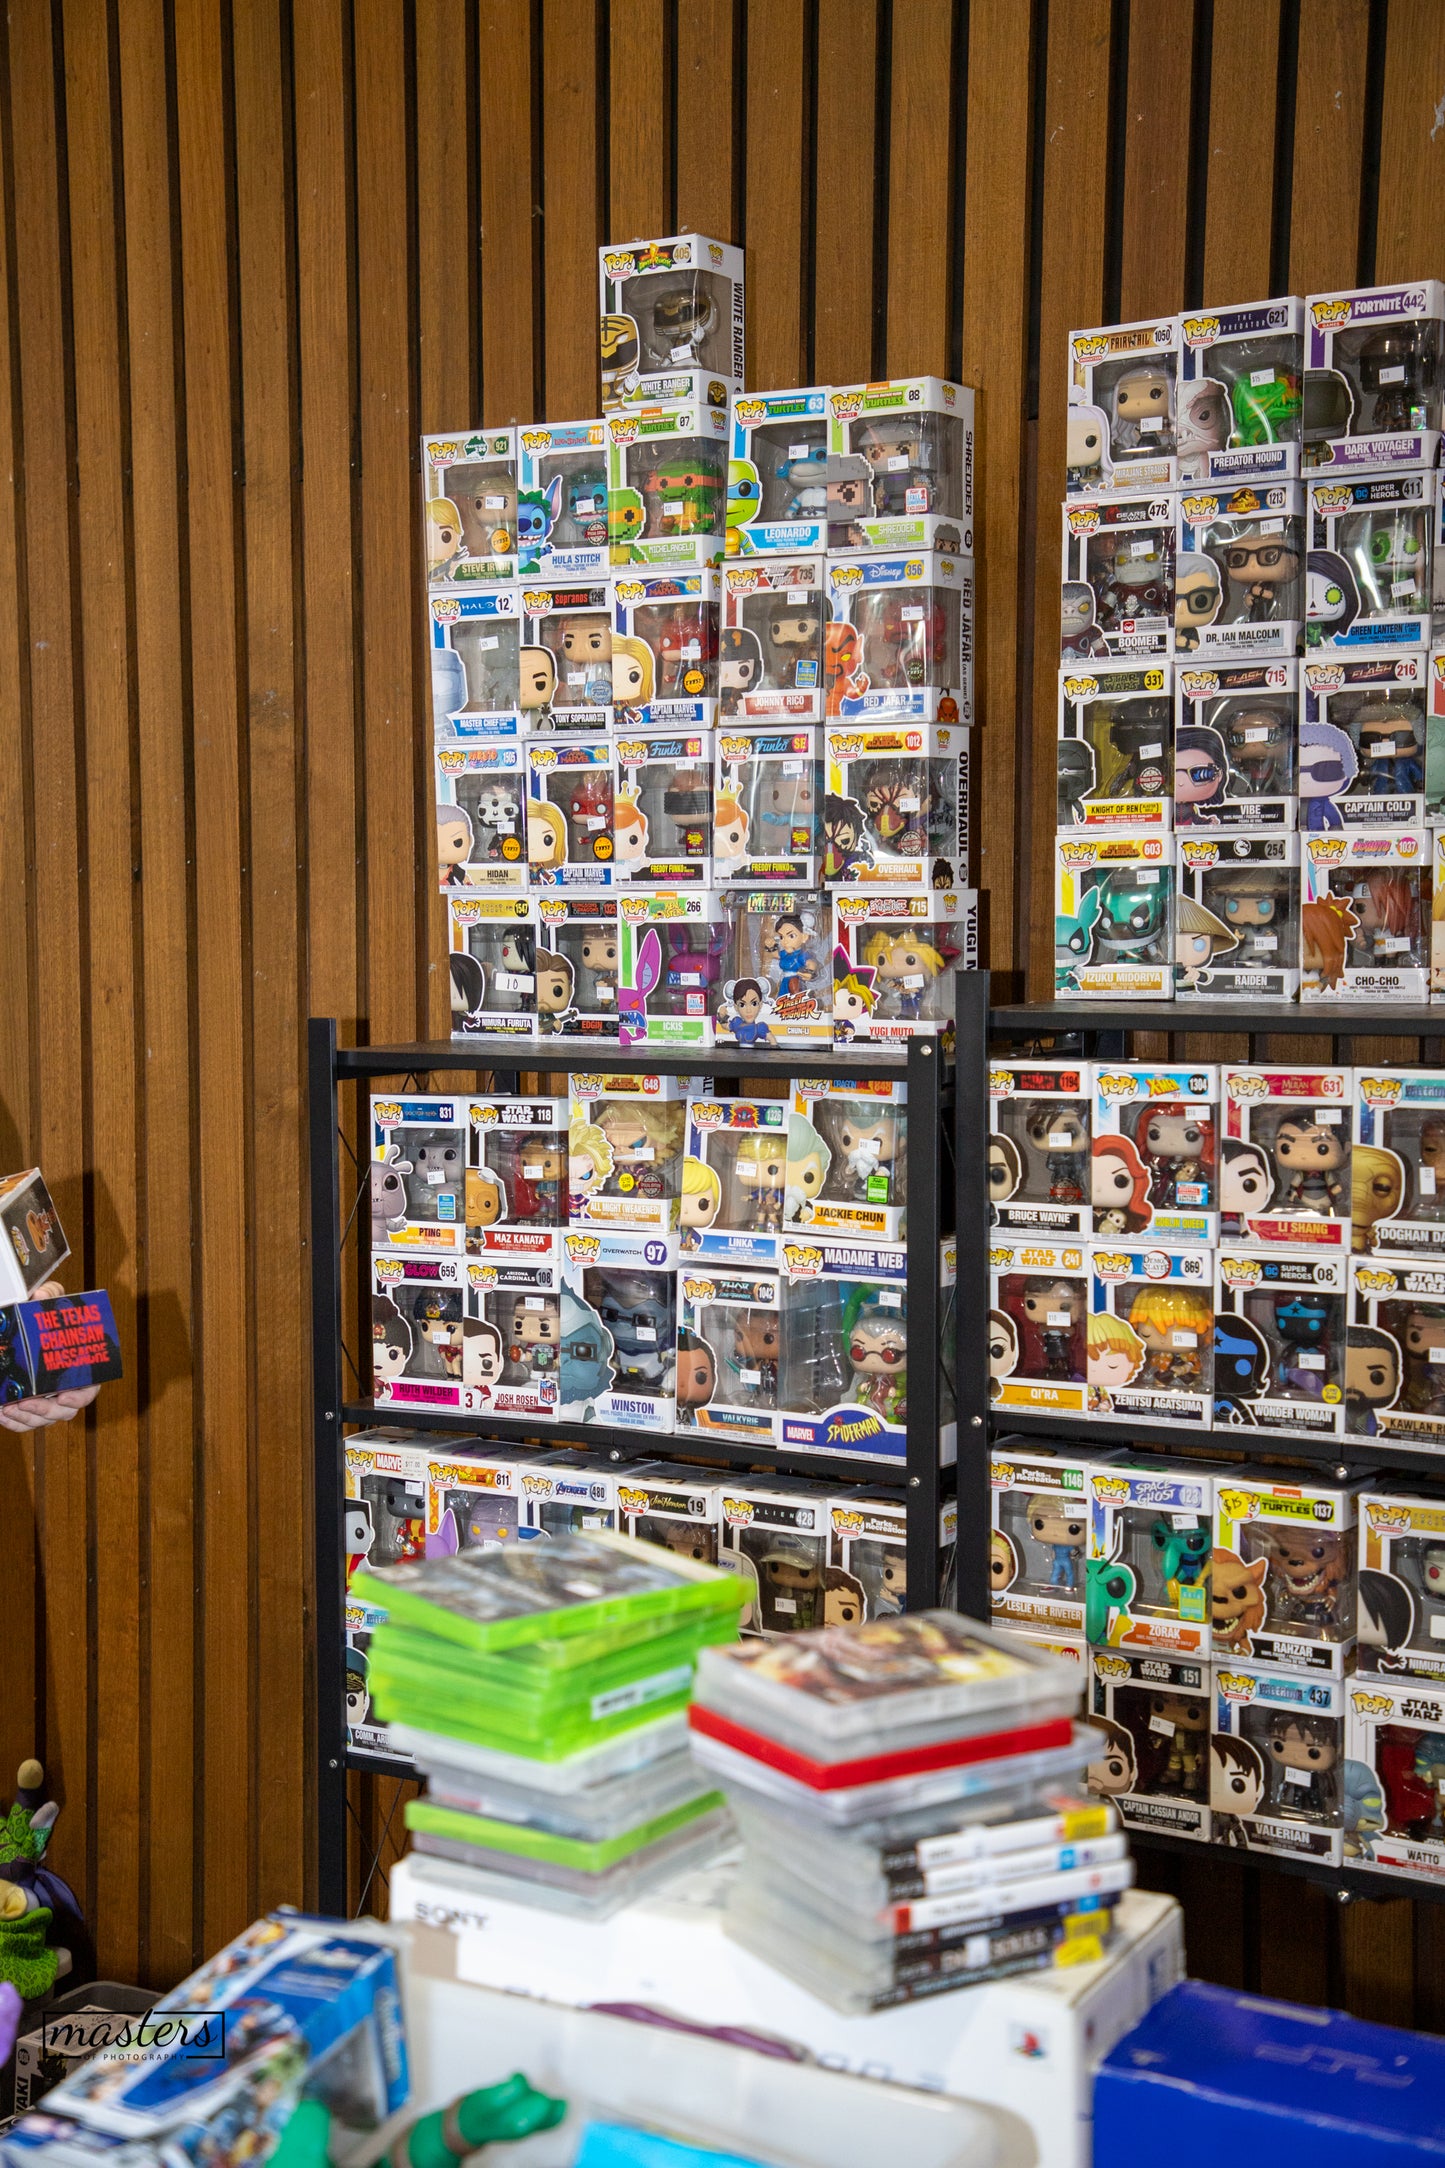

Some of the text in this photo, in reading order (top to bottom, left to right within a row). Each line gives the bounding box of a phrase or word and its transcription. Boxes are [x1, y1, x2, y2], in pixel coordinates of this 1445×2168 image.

[674, 248, 691, 261] 405
[1354, 296, 1401, 316] FORTNITE
[1404, 294, 1424, 308] 442
[1238, 313, 1252, 321] THE
[1269, 311, 1286, 325] 621
[734, 282, 743, 379] WHITE RANGER
[1154, 329, 1171, 342] 1050
[768, 404, 806, 413] TURTLES
[809, 397, 823, 409] 63
[865, 398, 903, 408] TURTLES
[589, 431, 603, 442] 718
[495, 441, 508, 451] 921
[1344, 438, 1414, 456] DARK VOYAGER
[1213, 451, 1283, 468] PREDATOR HOUND
[965, 430, 973, 515] SHREDDER
[1371, 484, 1395, 493] SUPER
[1371, 490, 1400, 500] HEROES
[1404, 482, 1422, 497] 411
[1269, 493, 1283, 505] 1213
[1149, 504, 1167, 517] 478
[765, 528, 811, 539] LEONARDO
[879, 525, 916, 535] SHREDDER
[552, 554, 601, 567] HULA STITCH
[869, 564, 902, 578] Disney
[907, 564, 922, 576] 356
[499, 598, 510, 611] 12
[1206, 629, 1280, 643] DR. IAN MALCOLM
[1350, 623, 1403, 636] GREEN LANTERN
[1119, 636, 1159, 647] BOOMER
[1268, 669, 1285, 683] 715
[1397, 665, 1415, 679] 216
[1146, 673, 1162, 686] 331
[864, 697, 906, 706] RED JAFAR
[651, 741, 682, 756] Funko
[755, 737, 788, 752] Funko
[958, 751, 968, 857] OVERHAUL
[1091, 803, 1138, 815] KNIGHT OF REN
[1240, 804, 1261, 815] VIBE
[1344, 800, 1412, 813] CAPTAIN COLD
[1144, 844, 1161, 857] 603
[1266, 843, 1284, 857] 254
[1399, 841, 1416, 854] 1037
[487, 870, 509, 878] HIDAN
[879, 863, 918, 873] OVERHAUL
[687, 902, 701, 913] 266
[751, 897, 792, 908] METALS
[911, 900, 927, 912] 715
[967, 905, 977, 957] YUGI
[1086, 971, 1160, 982] IZUKU MIDORIYA
[1234, 975, 1268, 986] RAIDEN
[1355, 976, 1399, 986] CHO-CHO
[507, 978, 519, 990] 10
[775, 993, 820, 1019] STREET FIGHTER
[481, 1019, 531, 1027] NIMURA FURUTA
[663, 1021, 683, 1031] ICKIS
[788, 1027, 809, 1035] CHUN-LI
[643, 1079, 659, 1090] 648
[1145, 1078, 1180, 1096] X-MEN
[1323, 1080, 1340, 1093] 631
[439, 1107, 453, 1119] 831
[504, 1106, 532, 1114] STAR
[537, 1109, 553, 1121] 118
[502, 1113, 534, 1123] WARS
[817, 1206, 885, 1225] JACKIE CHUN
[1009, 1211, 1071, 1223] BRUCE WAYNE
[419, 1227, 441, 1239] PTING
[1278, 1222, 1328, 1235] LI SHANG
[1380, 1227, 1429, 1242] DOGHAN
[494, 1233, 545, 1245] MAZ KANATA
[729, 1238, 753, 1249] LINKA
[603, 1247, 642, 1257] OVERWATCH
[646, 1244, 665, 1261] 97
[784, 1246, 821, 1268] POP!
[825, 1248, 904, 1269] MADAME WEB
[1022, 1248, 1055, 1258] STAR
[1021, 1257, 1056, 1267] WARS
[1184, 1261, 1200, 1273] 869
[404, 1264, 438, 1279] GLOW
[441, 1265, 456, 1279] 659
[1281, 1266, 1307, 1275] SUPER
[1281, 1272, 1313, 1282] HEROES
[500, 1275, 536, 1284] CARDINALS
[33, 1304, 102, 1331] THE TEXAS
[40, 1324, 105, 1351] CHAINSAW
[43, 1342, 110, 1373] MASSACRE
[399, 1383, 454, 1398] RUTH WILDER
[1031, 1387, 1059, 1401] QI'RA
[496, 1393, 539, 1406] JOSH ROSEN
[1115, 1394, 1202, 1411] ZENITSU AGATSUMA
[612, 1398, 655, 1415] WINSTON
[722, 1413, 760, 1426] VALKYRIE
[1256, 1406, 1332, 1423] WONDER WOMAN
[826, 1416, 881, 1443] SPIDER-MAN
[1390, 1417, 1432, 1433] KAWLAN
[786, 1426, 815, 1440] MARVEL
[376, 1453, 401, 1472] MARVE
[496, 1473, 510, 1486] 811
[1180, 1487, 1199, 1505] 123
[689, 1500, 704, 1512] 19
[1262, 1501, 1310, 1516] TURTLES
[1313, 1503, 1333, 1518] 1137
[1366, 1504, 1411, 1526] POP!
[1007, 1600, 1082, 1622] LESLIE THE RIVETER
[1149, 1624, 1180, 1638] ZORAK
[1273, 1641, 1313, 1658] RAHZAR
[1141, 1660, 1172, 1671] STAR
[1140, 1667, 1172, 1679] WARS
[1182, 1671, 1200, 1685] 151
[1309, 1687, 1330, 1706] 437
[1350, 1692, 1394, 1717] POP!
[1401, 1698, 1443, 1712] STAR
[1401, 1707, 1444, 1721] WARS
[355, 1729, 377, 1744] COMM.
[1123, 1800, 1199, 1824] CAPTAIN CASSIAN ANDOR
[1256, 1822, 1311, 1843] VALERIAN
[1408, 1849, 1440, 1865] WATTO
